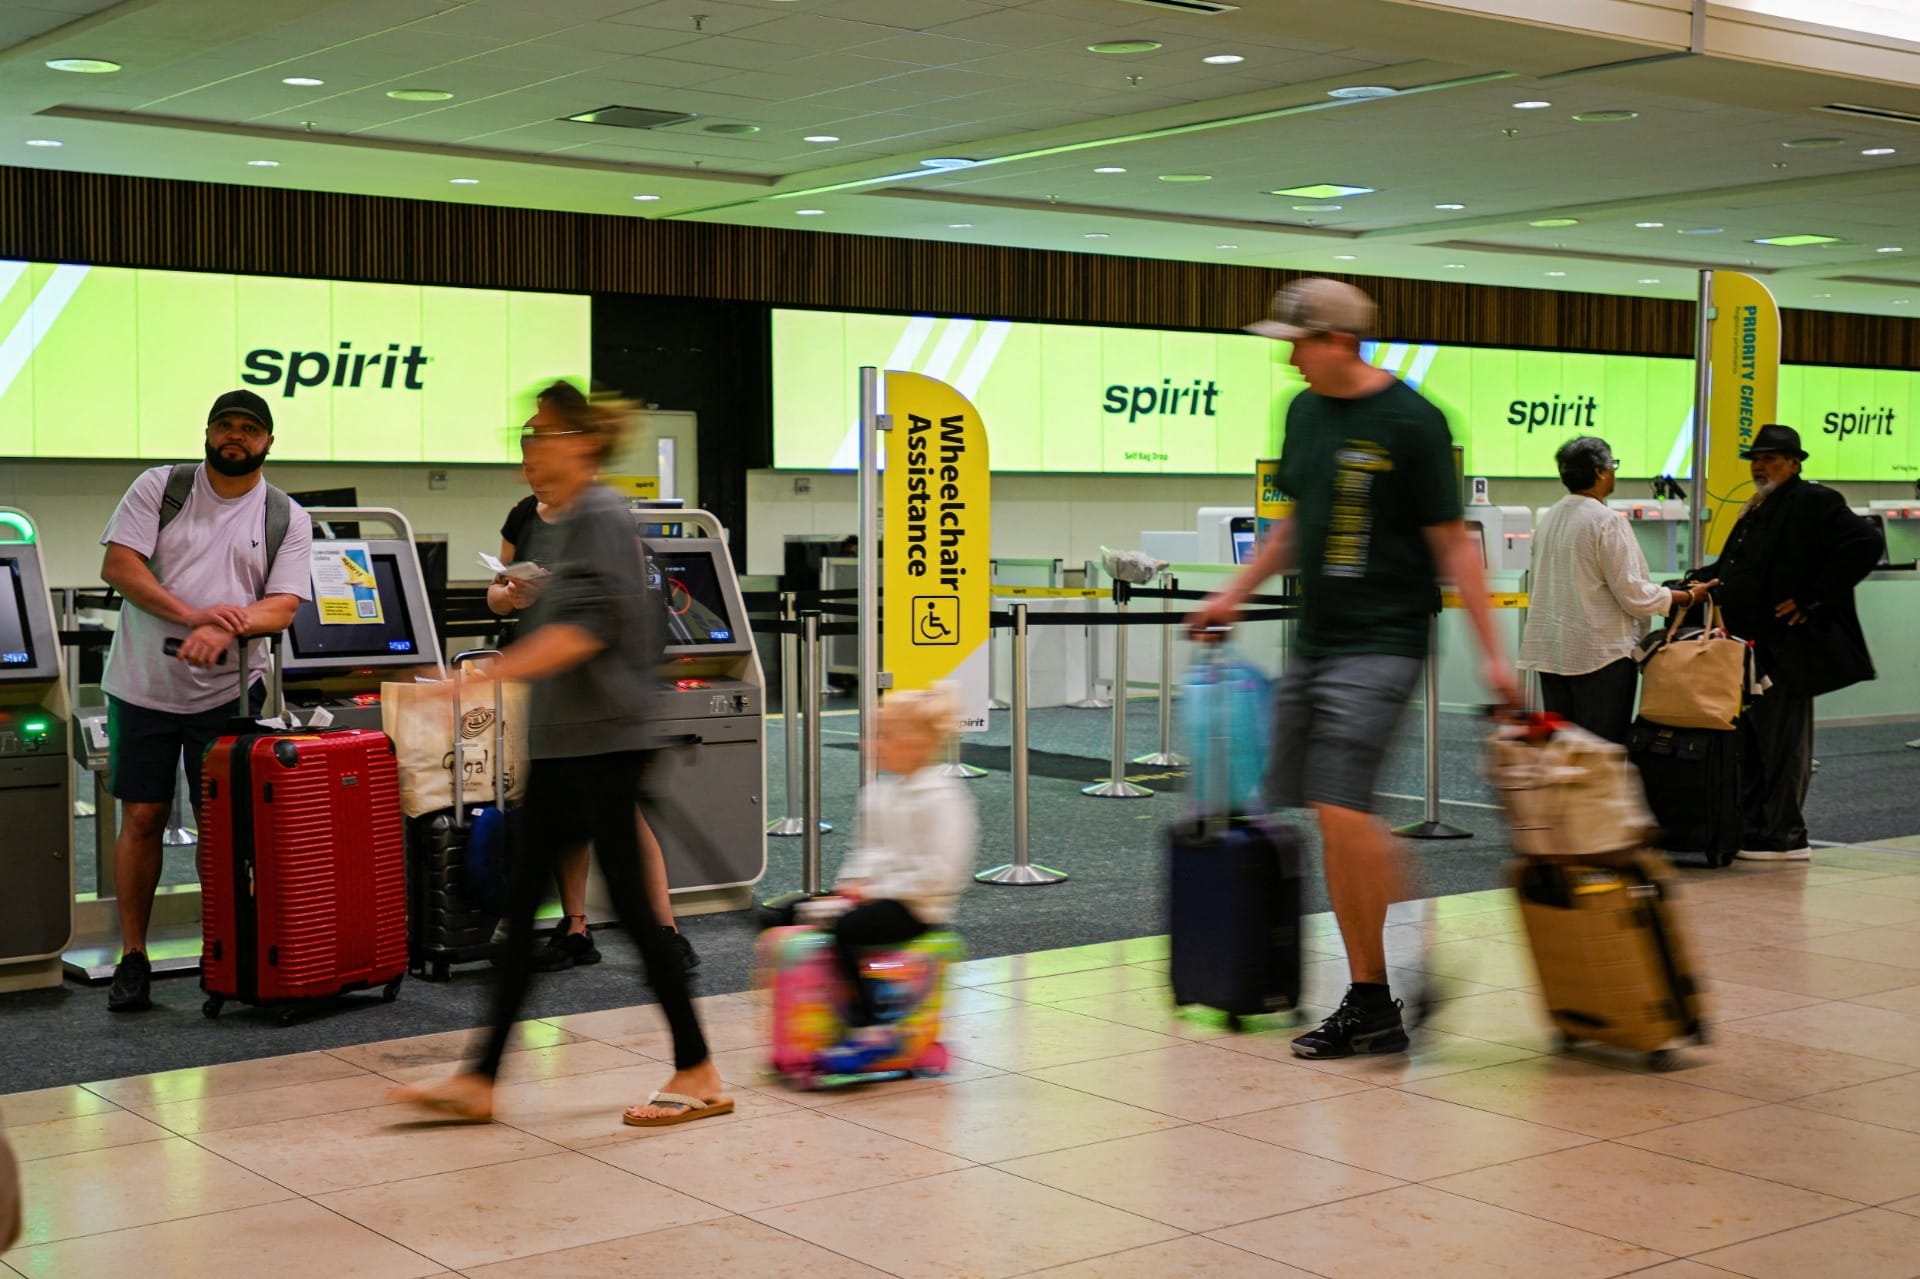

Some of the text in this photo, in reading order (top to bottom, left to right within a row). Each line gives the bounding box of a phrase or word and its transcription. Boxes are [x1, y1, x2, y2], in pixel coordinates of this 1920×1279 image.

[241, 341, 428, 398] spirit
[1741, 305, 1757, 380] PRIORITY
[1102, 378, 1219, 424] spirit
[1507, 394, 1597, 434] spirit
[1822, 406, 1895, 442] spirit
[908, 414, 935, 577] Assistance
[940, 415, 966, 592] Wheelchair
